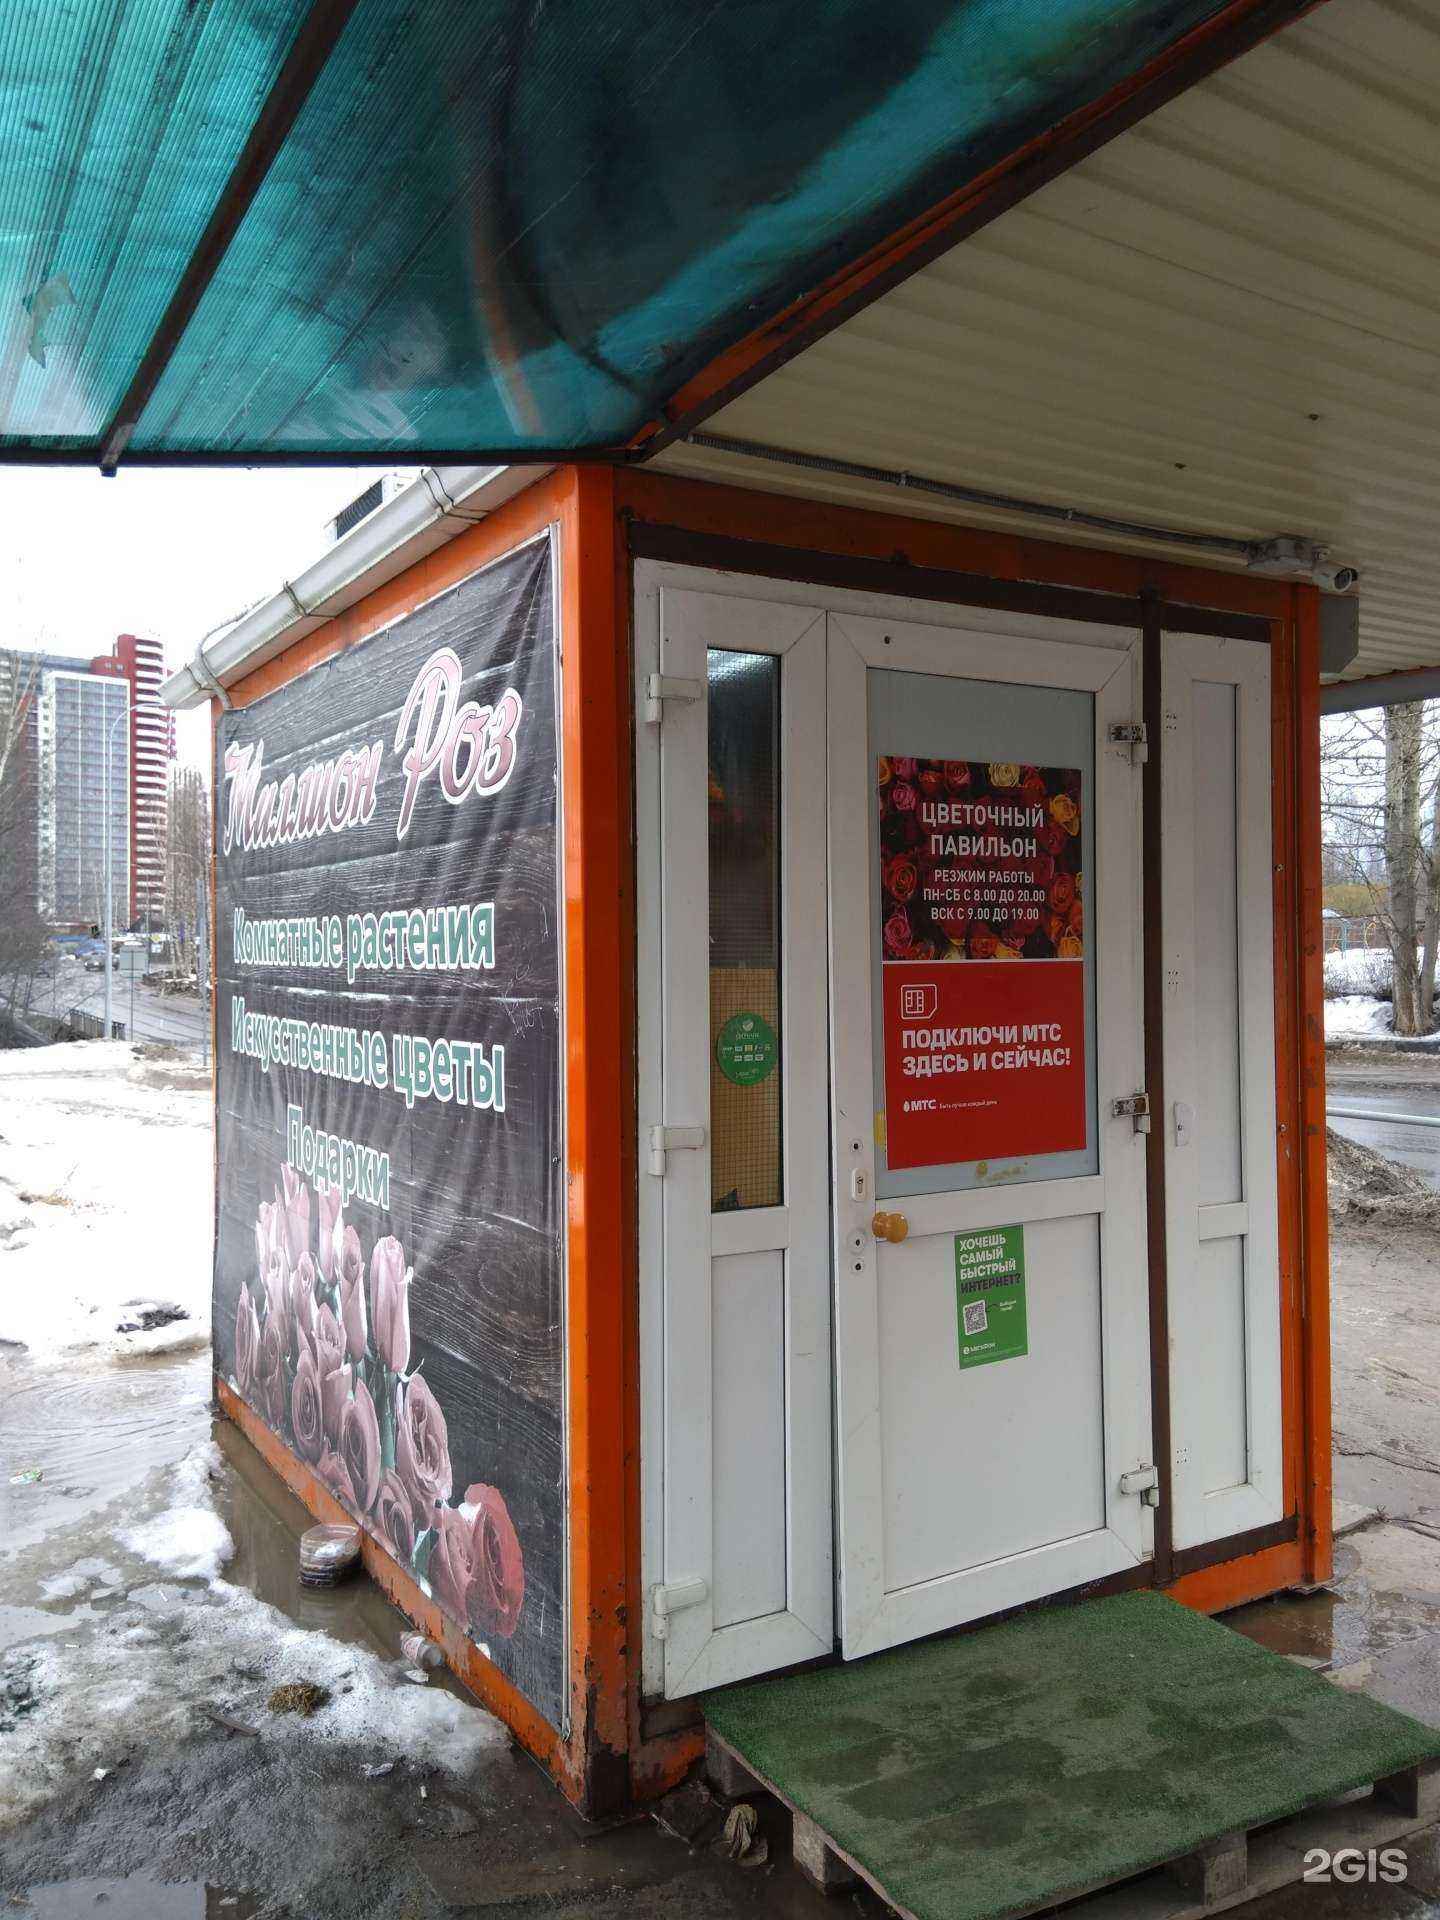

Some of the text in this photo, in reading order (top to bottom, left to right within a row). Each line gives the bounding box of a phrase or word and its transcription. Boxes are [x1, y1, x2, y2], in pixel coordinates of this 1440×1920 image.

[394, 647, 522, 841] Роз
[922, 802, 1044, 828] ЦВЕТОЧНЫЙ
[931, 835, 1037, 858] ПАВИЛЬОН
[934, 869, 1034, 884] РЕЗЖИМ РАБОТЫ
[923, 889, 1045, 903] ПН-СБ С 8.00 ДО 20.00
[931, 908, 1039, 922] ВСК С 9.00 ДО 19.00
[234, 902, 495, 984] Комнатные растения
[902, 1023, 1062, 1051] ПОДКЛЮЧИ МТС
[231, 996, 506, 1112] Искусственные цветы
[902, 1045, 1071, 1078] ЗДЕСЬ И СЕЙЧАС!
[910, 1099, 937, 1112] МТС
[287, 1103, 390, 1210] Подарки
[959, 1233, 1007, 1252] ХОЧЕШЬ
[959, 1245, 1004, 1266] САМЫЙ
[960, 1257, 1017, 1281] БЫСТРЫЙ
[960, 1273, 1021, 1295] ИНТЕРНЕТ?
